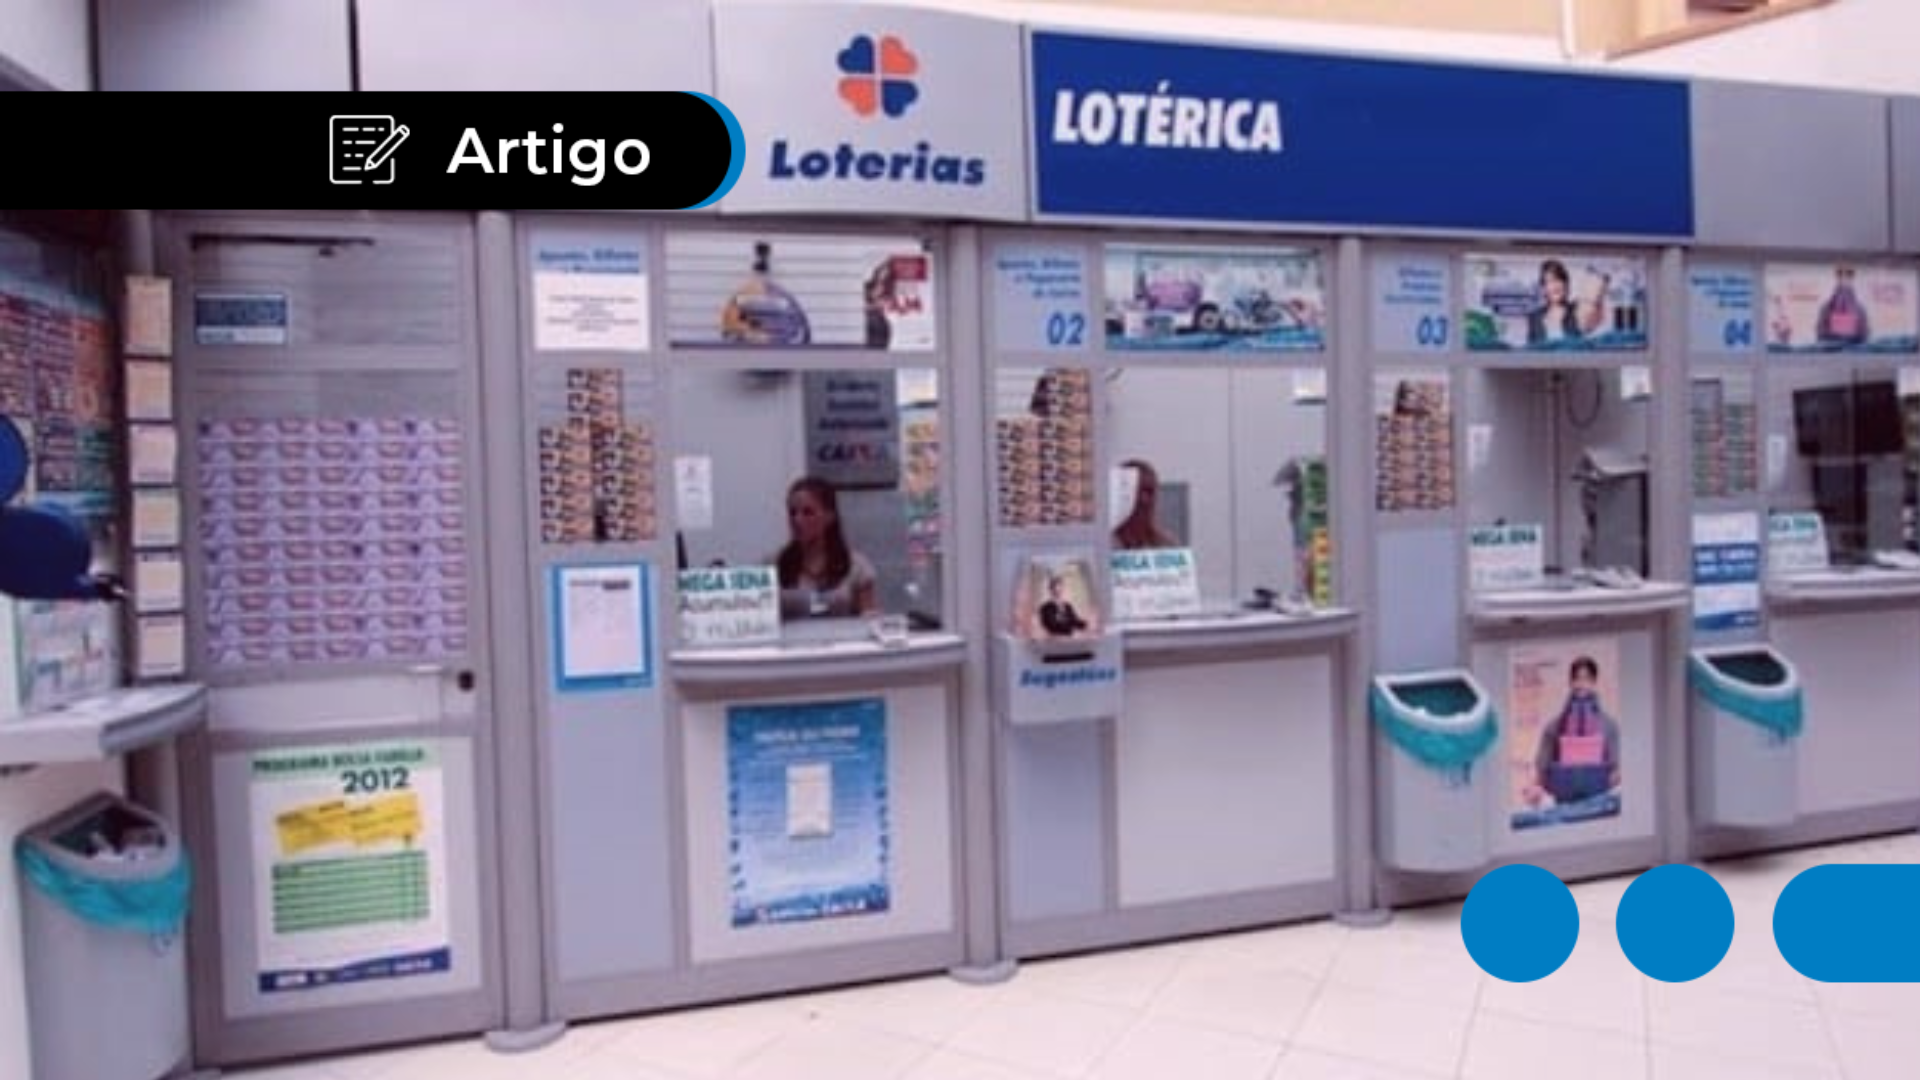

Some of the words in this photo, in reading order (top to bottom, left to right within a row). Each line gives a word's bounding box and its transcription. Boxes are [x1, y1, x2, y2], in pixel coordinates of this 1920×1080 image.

[1053, 79, 1283, 153] LOTÉRICA
[768, 139, 985, 186] Loterias
[1046, 311, 1085, 345] 02
[1417, 315, 1448, 346] 03
[1724, 319, 1752, 346] 04
[678, 573, 725, 593] MEGA
[730, 571, 770, 591] SENA
[341, 766, 410, 794] 2012
